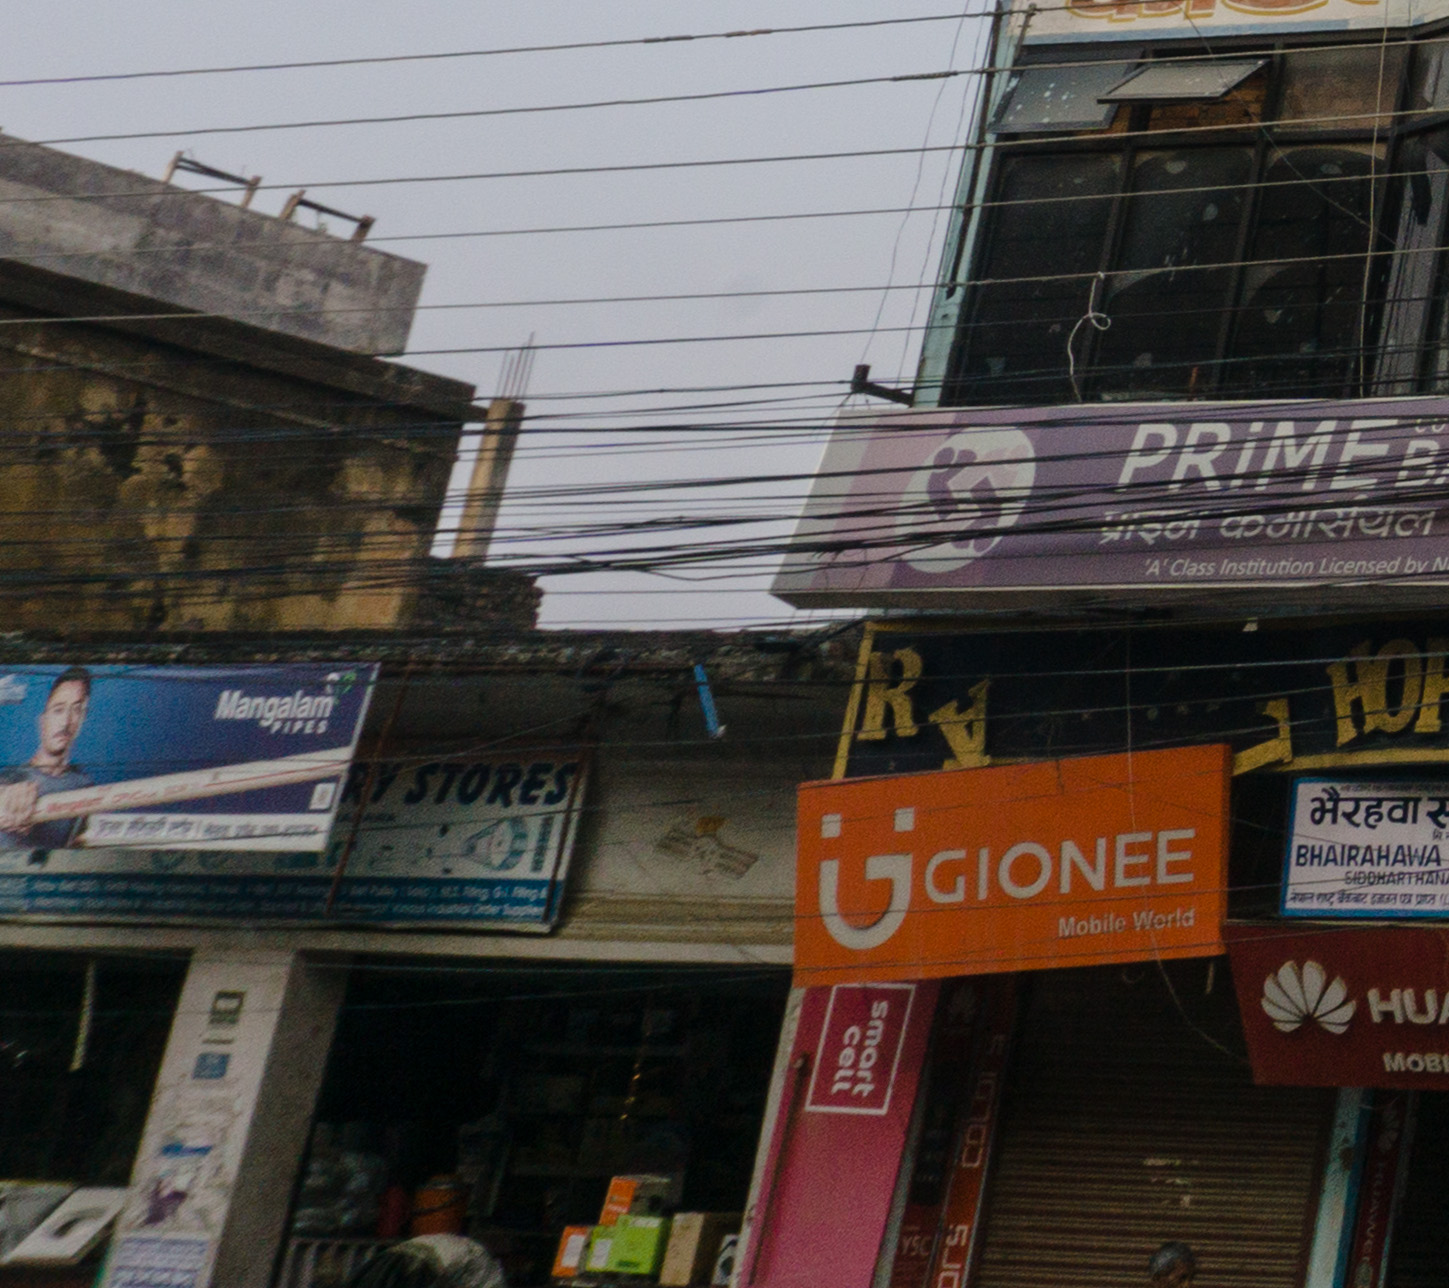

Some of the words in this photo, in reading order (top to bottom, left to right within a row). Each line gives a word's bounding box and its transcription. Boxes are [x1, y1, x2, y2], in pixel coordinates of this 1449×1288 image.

[1170, 559, 1216, 576] Class
[1219, 557, 1317, 576] Institution
[1319, 557, 1403, 575] Licensed
[1405, 557, 1426, 578] by
[212, 688, 334, 727] Mangalam
[270, 720, 328, 735] PIPES
[404, 762, 581, 807] STORES
[1310, 786, 1421, 829] भैरहवा
[924, 827, 1196, 904] GIONEE
[1295, 844, 1441, 867] BHAIRAHAWA
[1058, 915, 1127, 938] Mobile
[1133, 907, 1196, 931] World
[830, 1025, 862, 1096] cell
[852, 999, 890, 1098] smart
